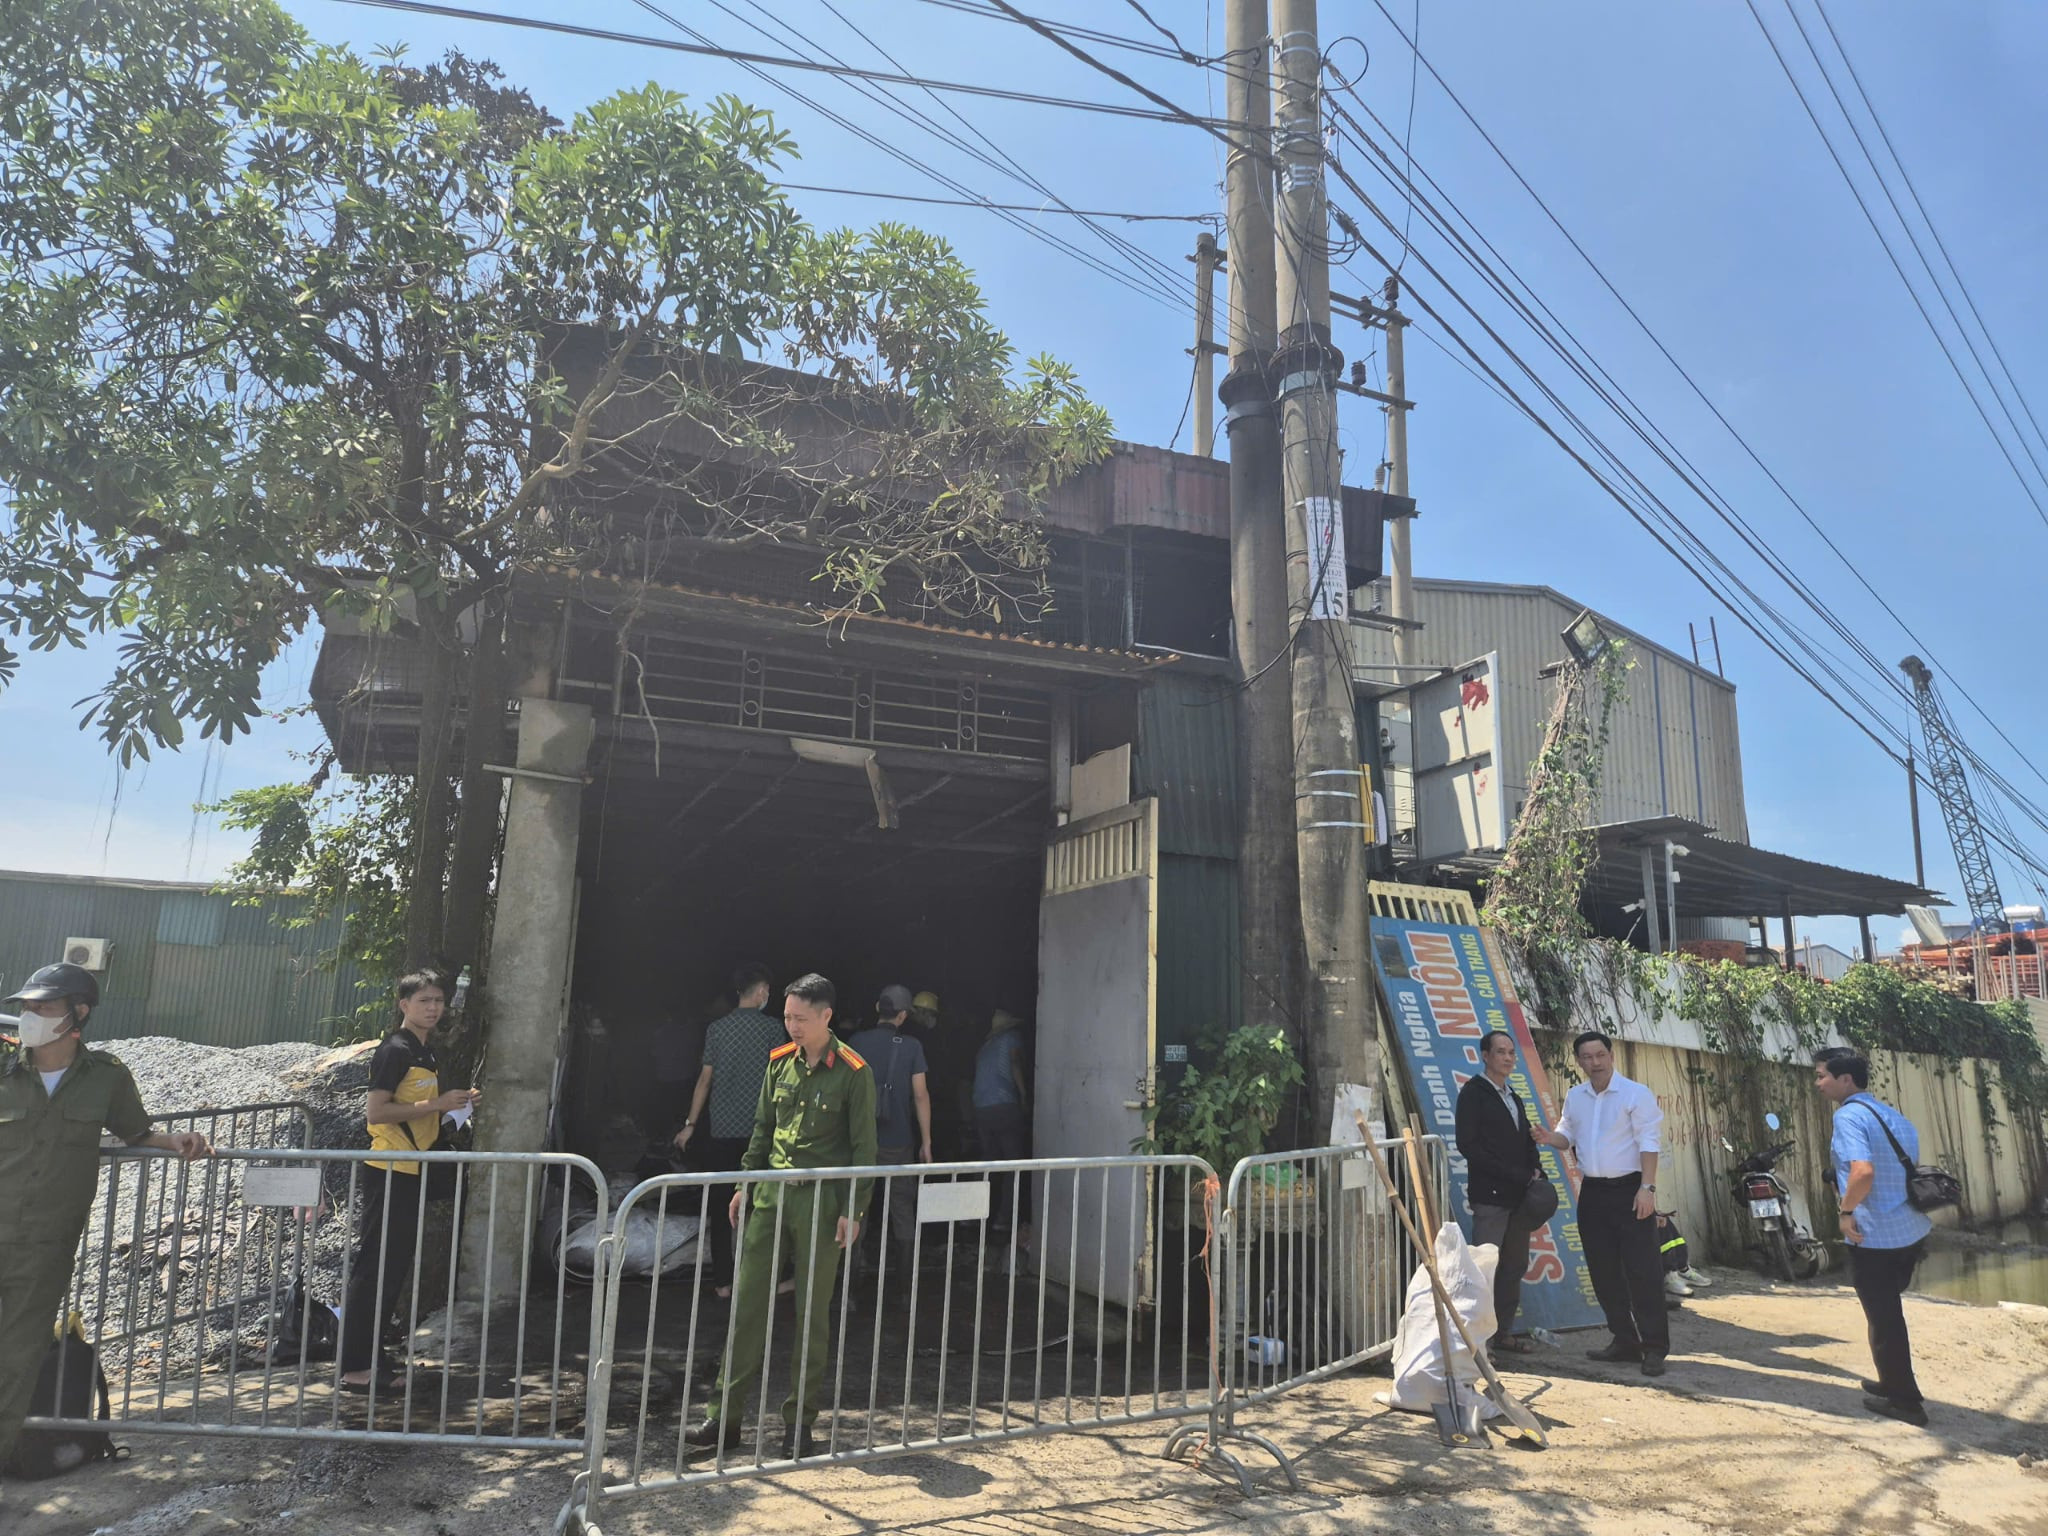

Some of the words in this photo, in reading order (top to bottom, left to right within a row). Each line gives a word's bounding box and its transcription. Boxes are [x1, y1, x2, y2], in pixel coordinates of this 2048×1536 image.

[1320, 591, 1344, 617] 15
[1459, 933, 1488, 972] THANG
[1405, 930, 1483, 1039] NHÔM
[1398, 991, 1435, 1058] Nghĩa
[1421, 1065, 1456, 1126] Danh
[1539, 1150, 1561, 1179] CAN
